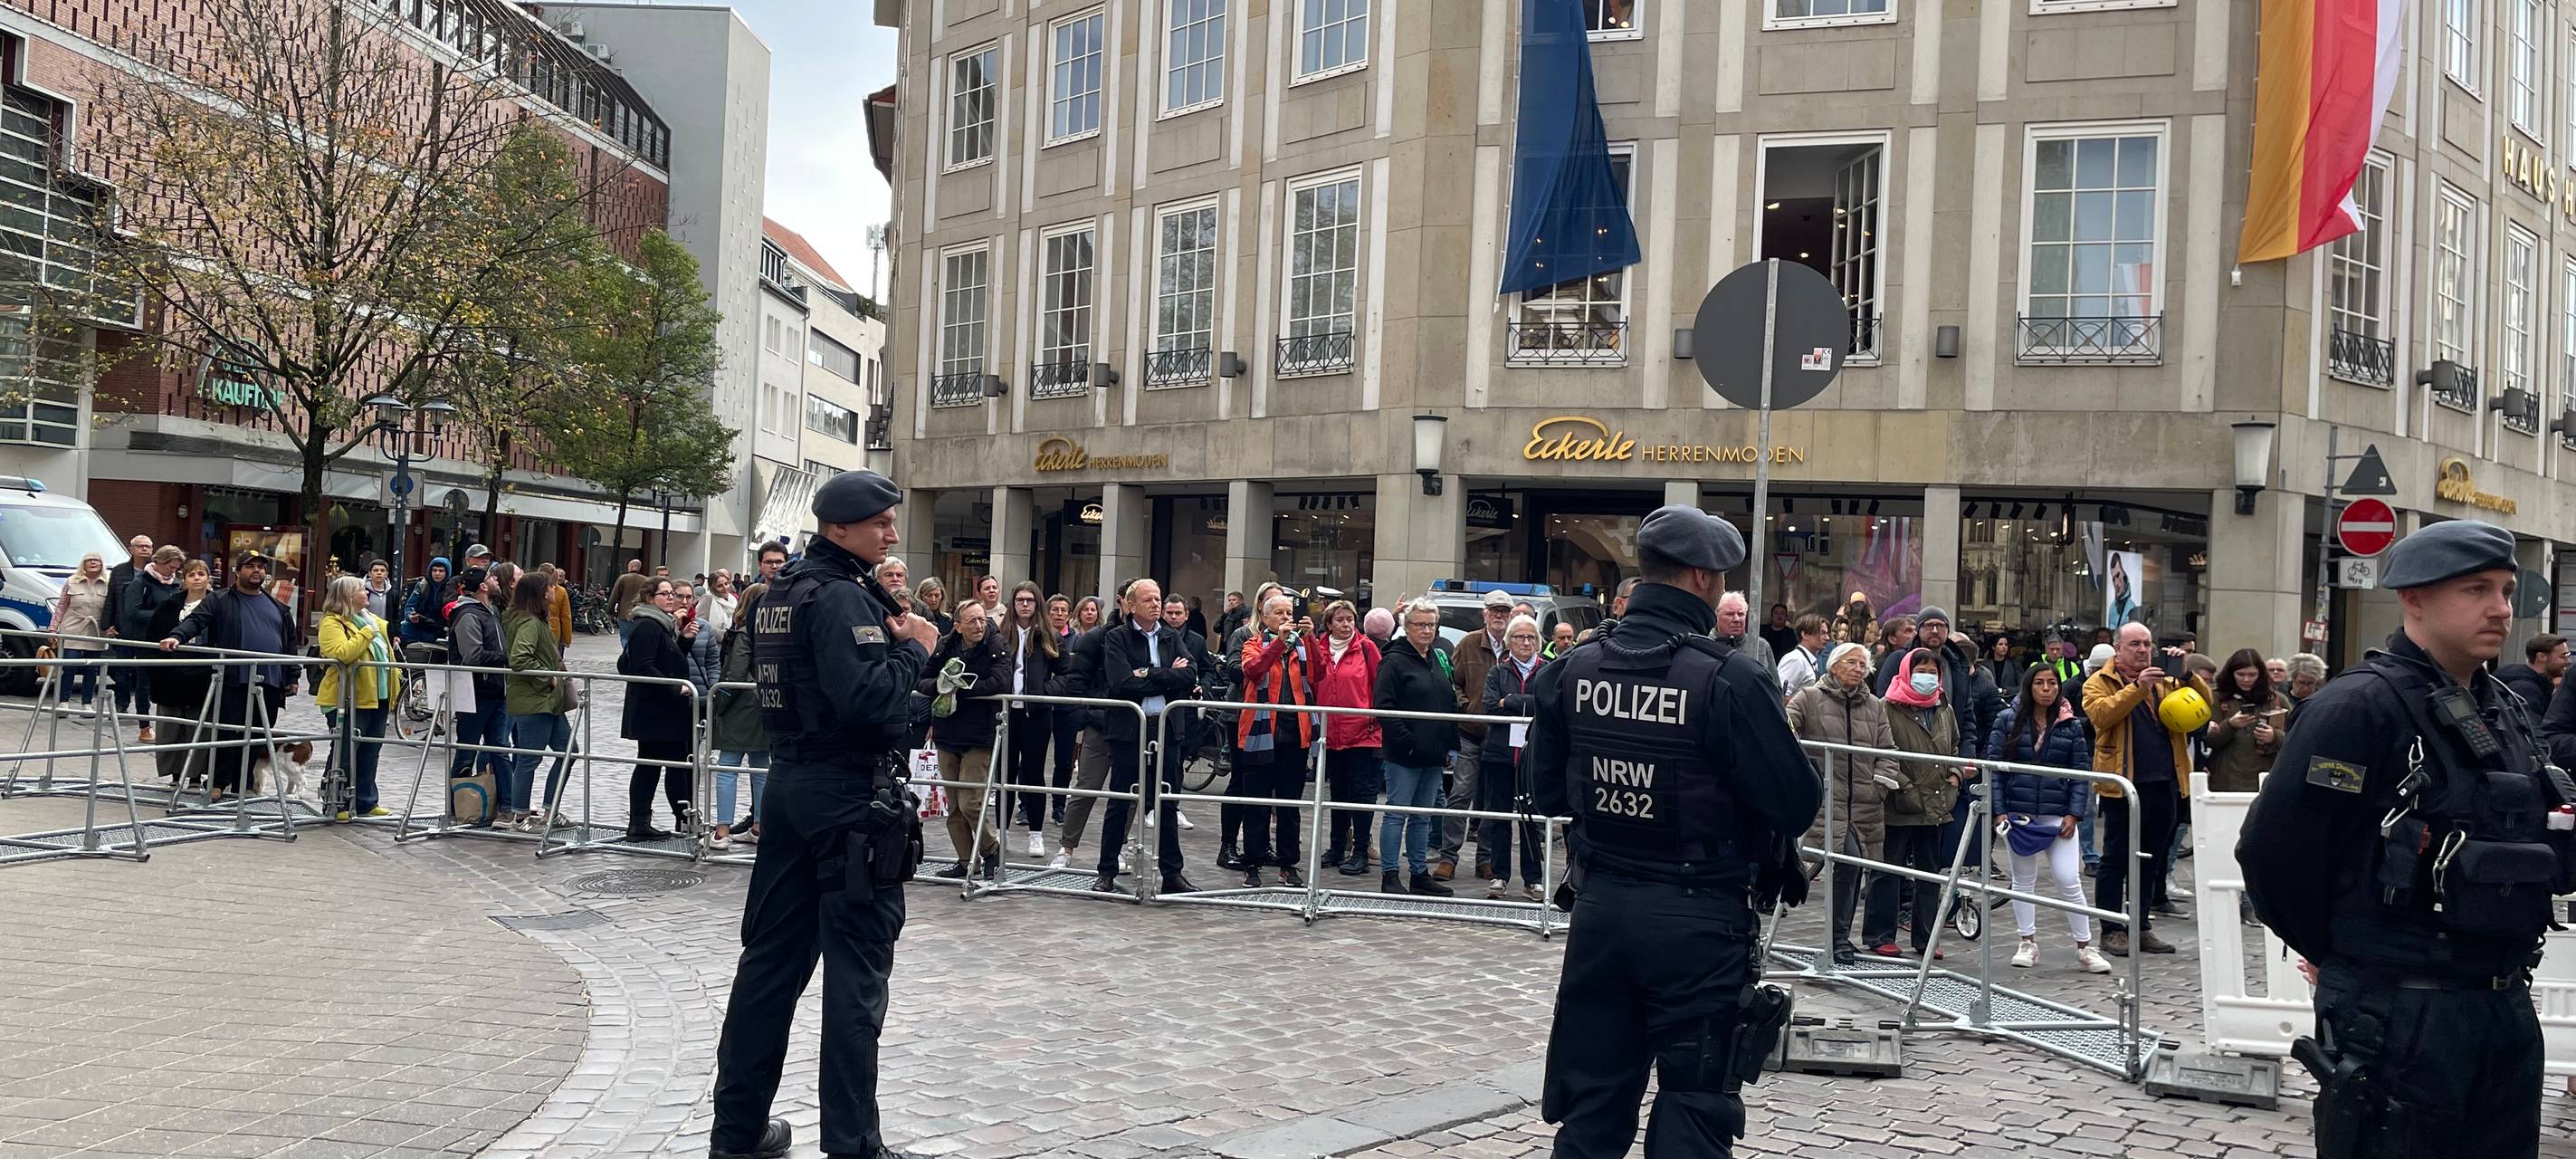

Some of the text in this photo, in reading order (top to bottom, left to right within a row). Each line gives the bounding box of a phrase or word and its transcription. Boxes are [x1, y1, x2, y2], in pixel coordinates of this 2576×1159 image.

[2503, 135, 2576, 217] HAUS H
[1033, 435, 1169, 472] Eckerle HERRENMODEN
[1522, 416, 1805, 465] Eckerle HERRENMODEN
[234, 533, 252, 547] glo
[755, 606, 793, 634] POLIZEI
[760, 688, 783, 708] 2632
[1575, 679, 1687, 724] POLIZEI
[1593, 756, 1655, 789] NRW
[1595, 787, 1654, 819] 2632
